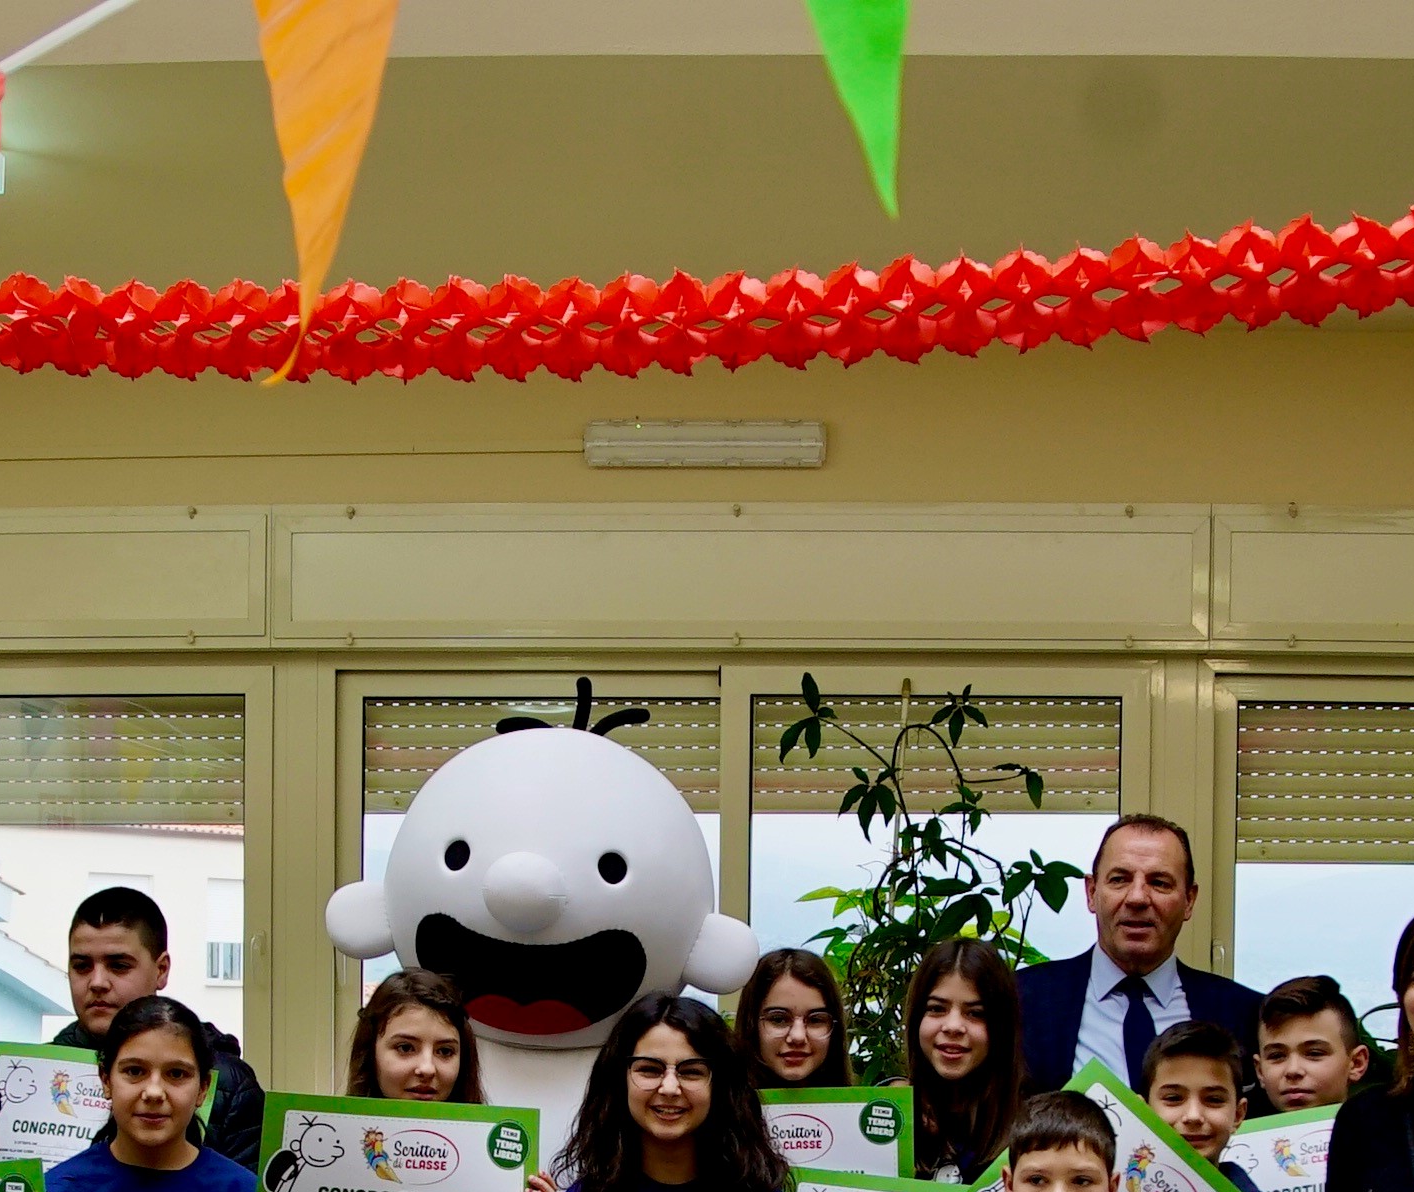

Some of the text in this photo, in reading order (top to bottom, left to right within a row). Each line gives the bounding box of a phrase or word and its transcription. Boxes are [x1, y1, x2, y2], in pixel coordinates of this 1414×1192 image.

[83, 1098, 113, 1110] CLASS
[12, 1120, 95, 1140] CONGRATUL
[771, 1124, 822, 1139] Scrittori
[393, 1140, 449, 1159] Scrittori
[783, 1140, 822, 1149] CLASSE
[392, 1157, 447, 1171] di CLASSE
